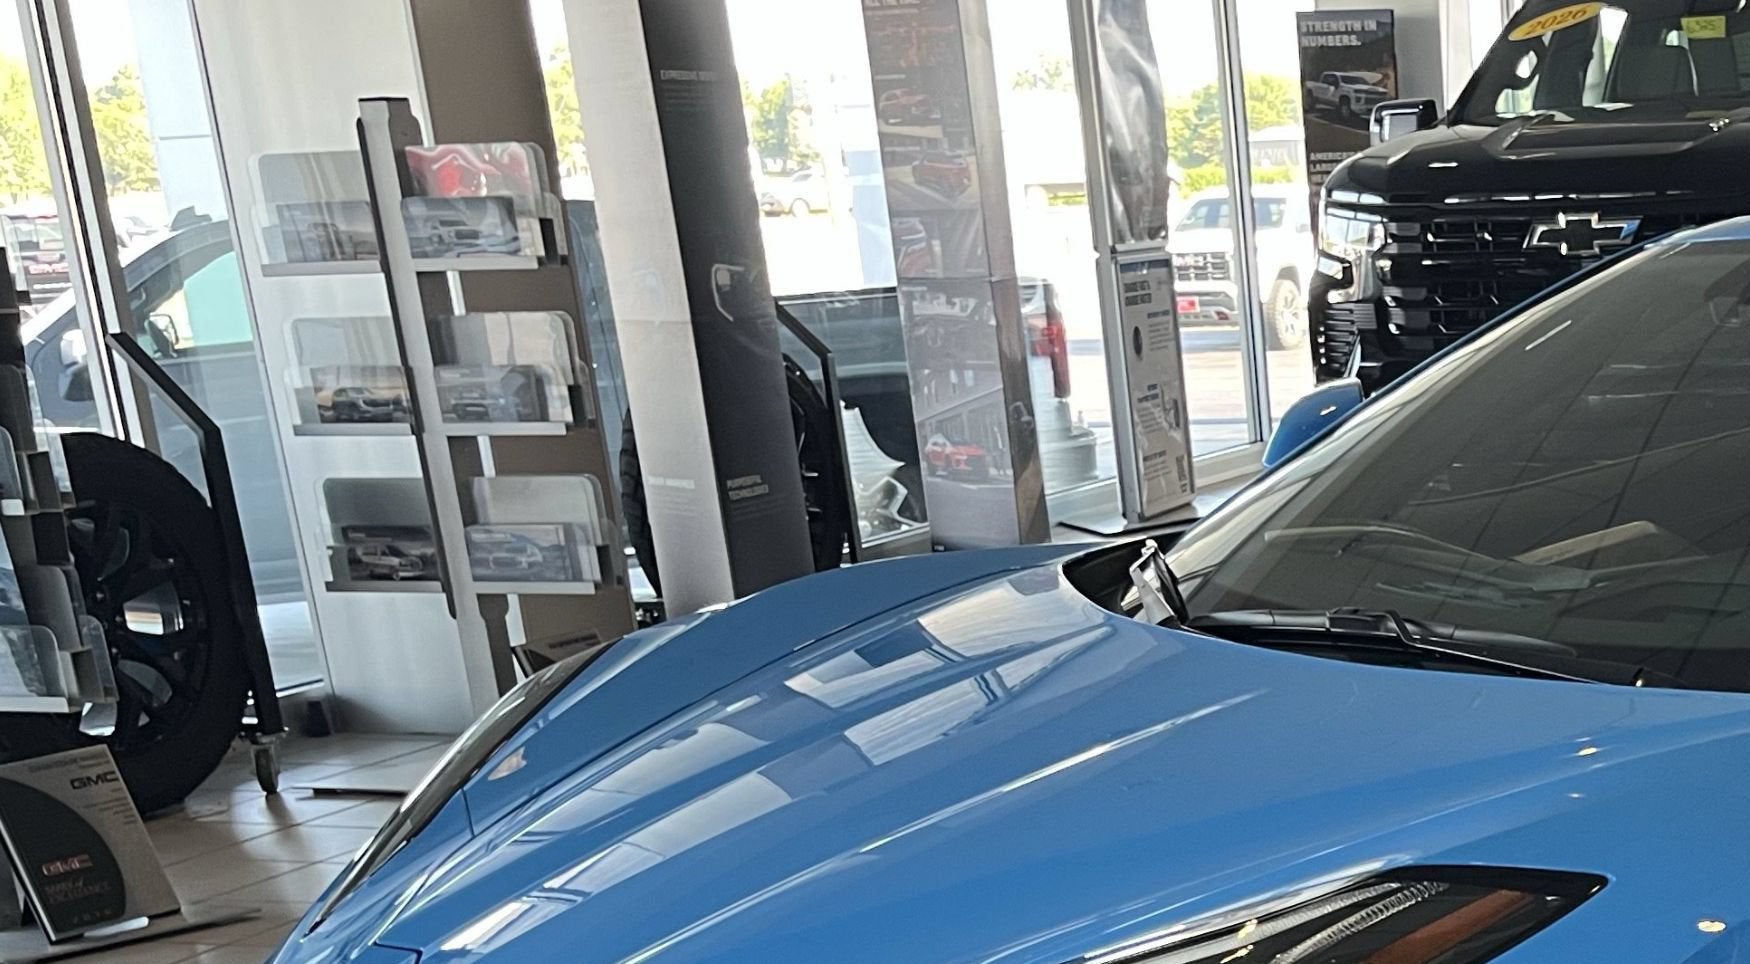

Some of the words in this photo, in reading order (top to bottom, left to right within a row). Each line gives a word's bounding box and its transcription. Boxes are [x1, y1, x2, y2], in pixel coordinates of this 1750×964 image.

[1301, 21, 1361, 32] STRENGTH
[1364, 20, 1376, 31] IN
[1525, 9, 1587, 35] 2026
[1301, 35, 1362, 46] NUMBERS.
[70, 771, 119, 789] GMC
